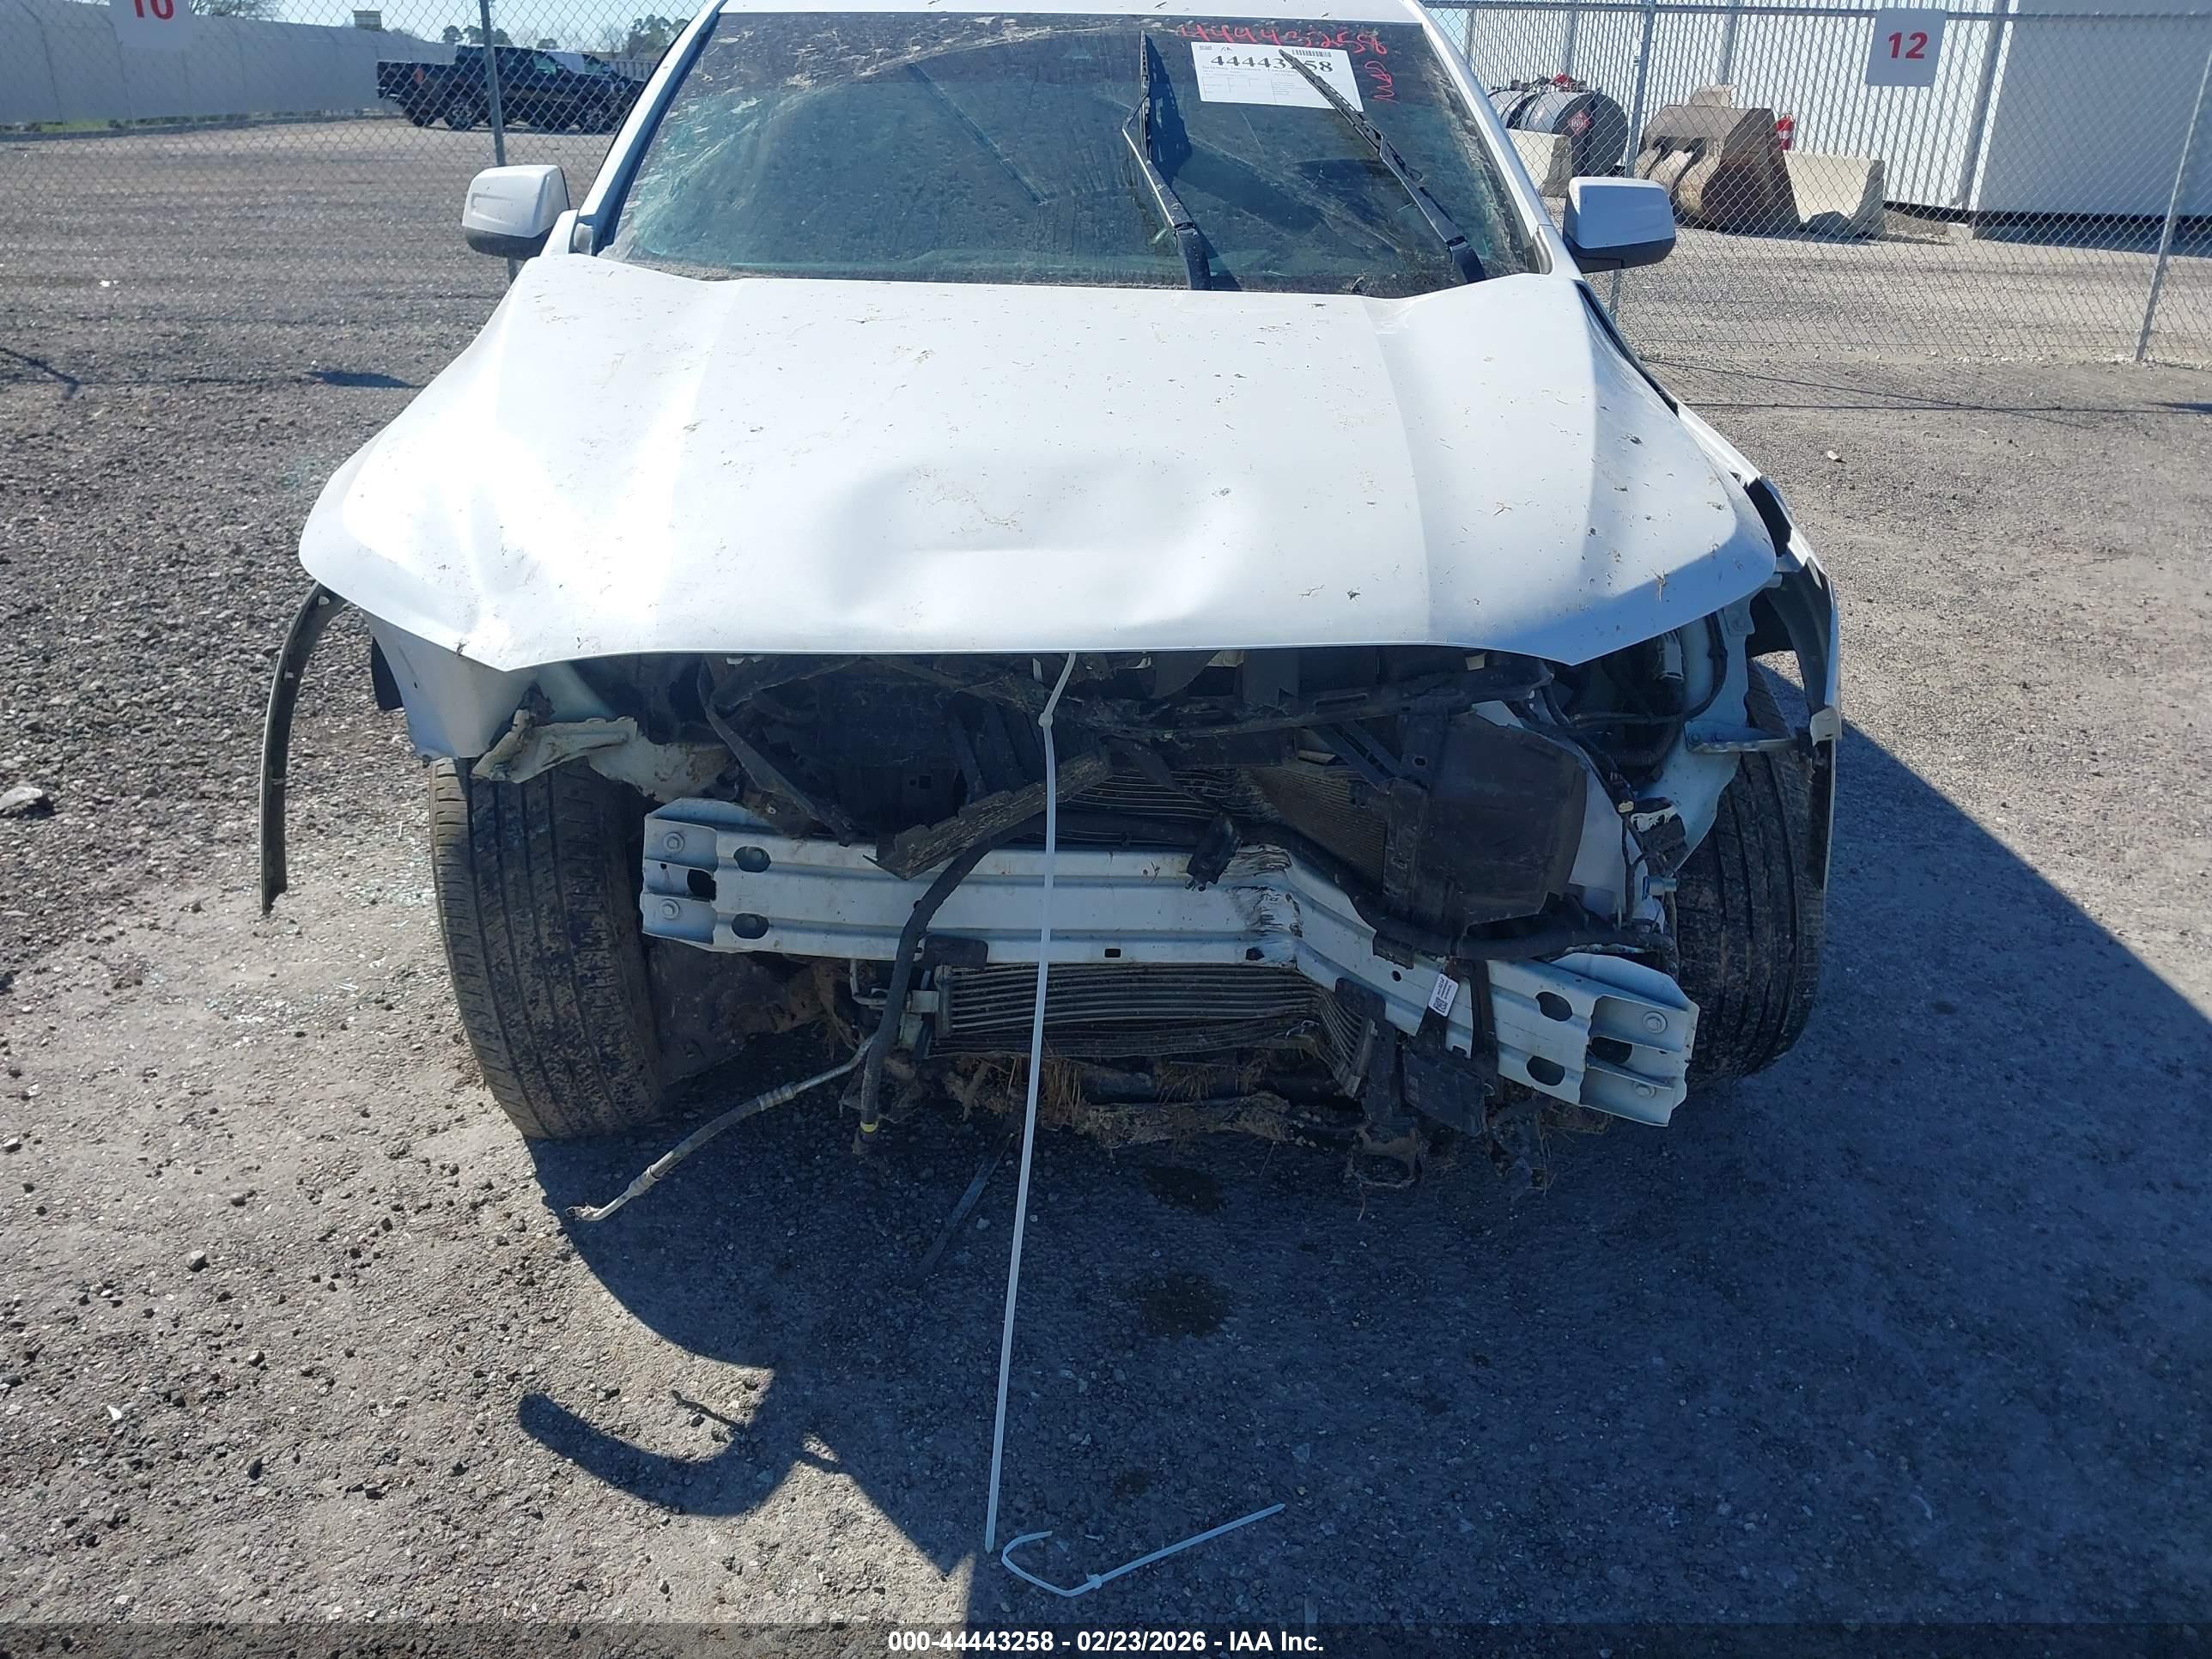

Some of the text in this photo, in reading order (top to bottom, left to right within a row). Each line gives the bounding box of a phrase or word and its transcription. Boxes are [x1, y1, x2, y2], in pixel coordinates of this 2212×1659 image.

[135, 0, 174, 20] 10
[1888, 32, 1928, 59] 12
[1210, 55, 1334, 73] 4444358
